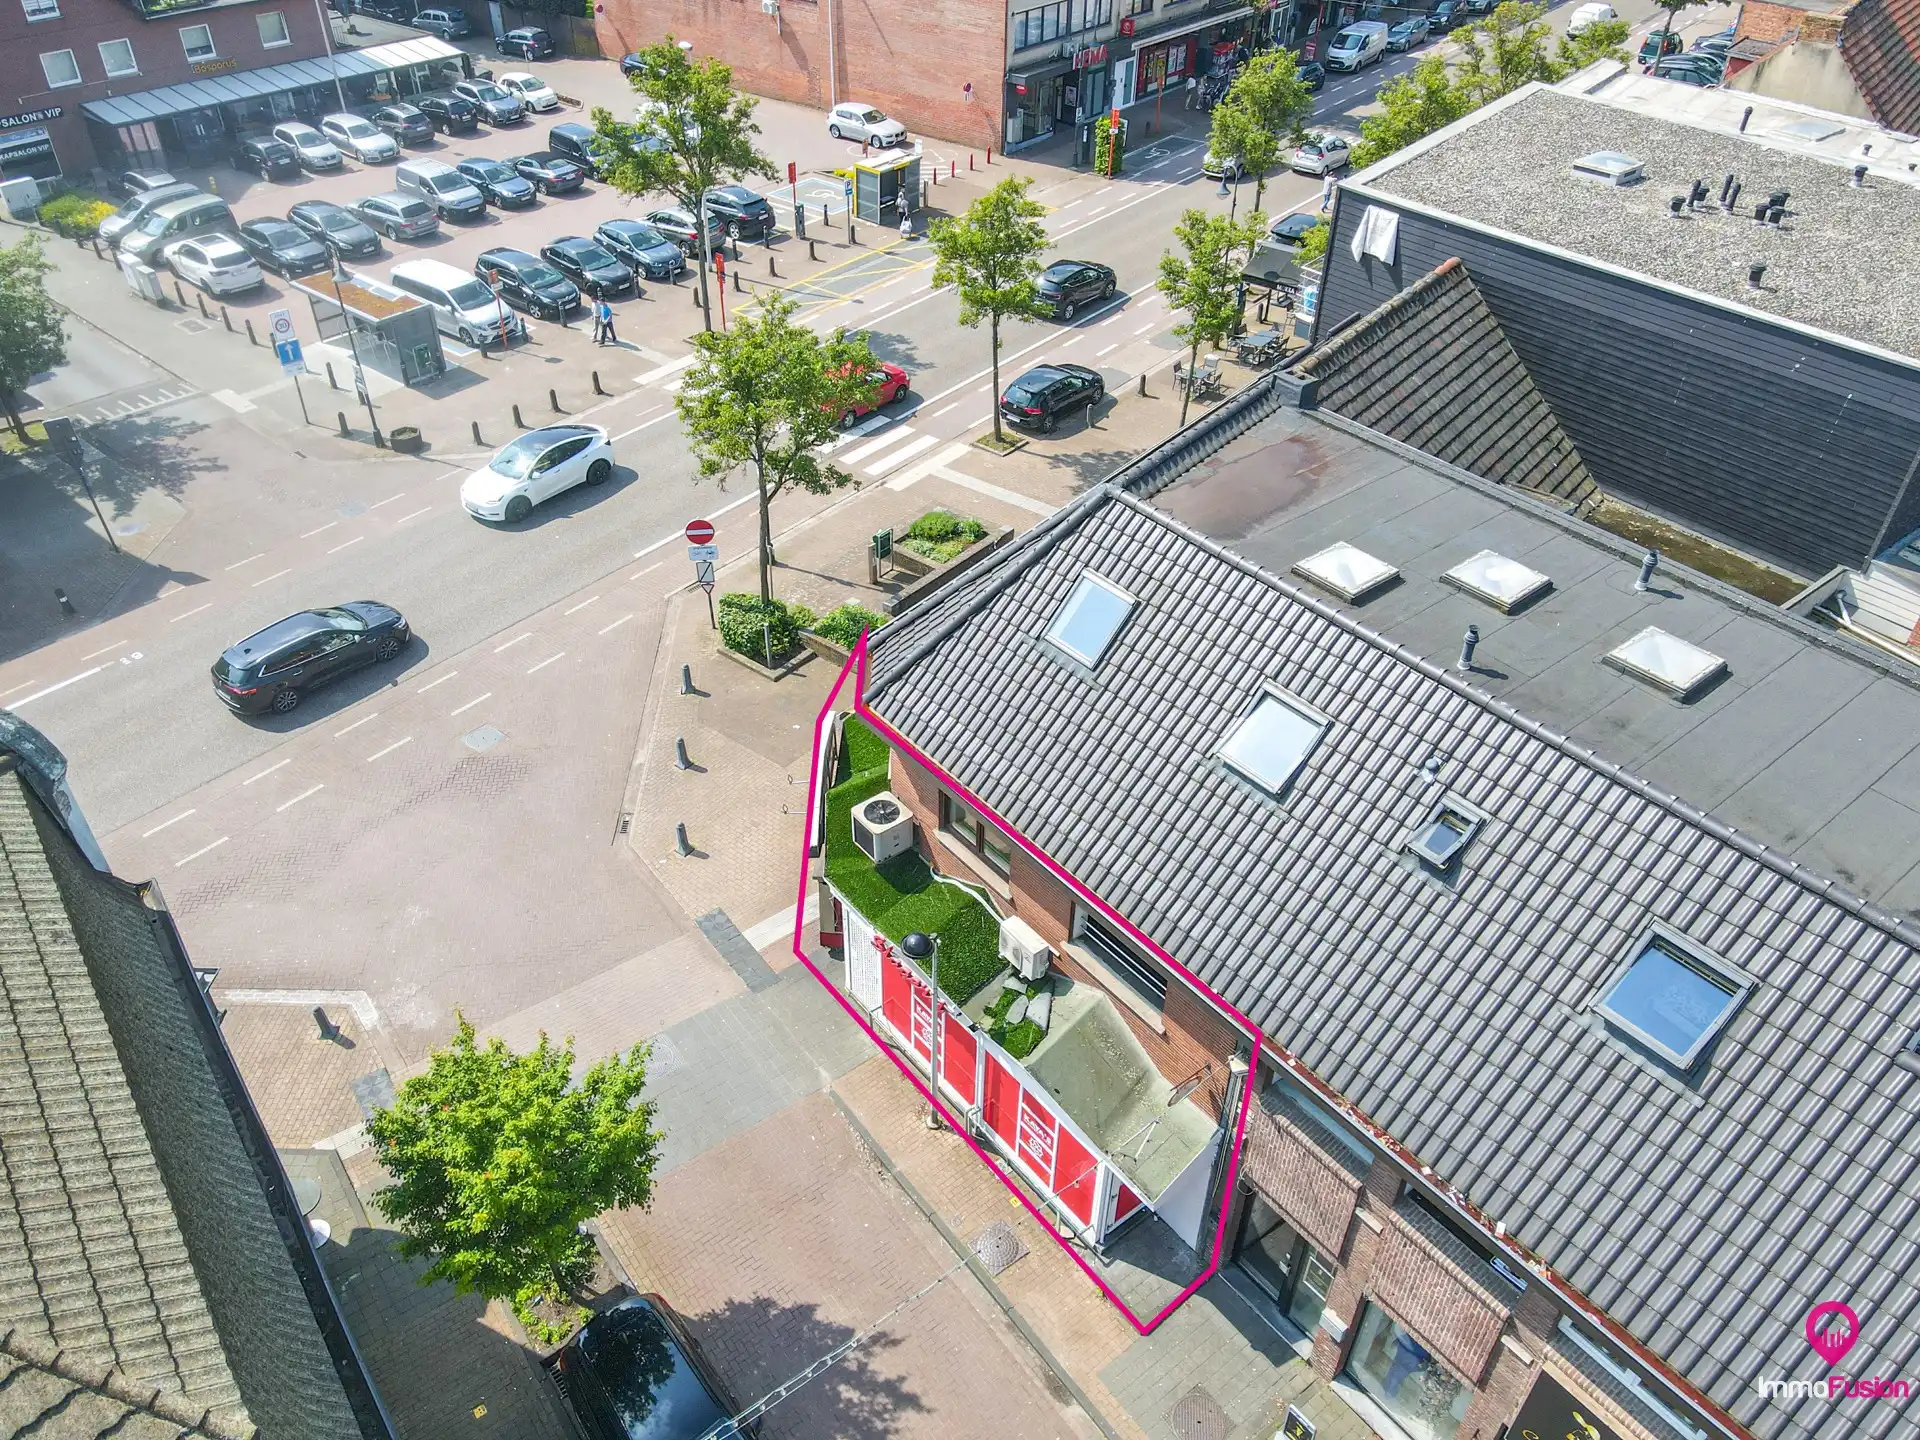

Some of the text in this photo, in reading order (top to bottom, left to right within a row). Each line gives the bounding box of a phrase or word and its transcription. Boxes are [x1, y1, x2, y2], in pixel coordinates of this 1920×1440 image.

[1072, 44, 1108, 71] HEMA
[0, 107, 61, 128] SALON VIP
[37, 144, 49, 152] VIP
